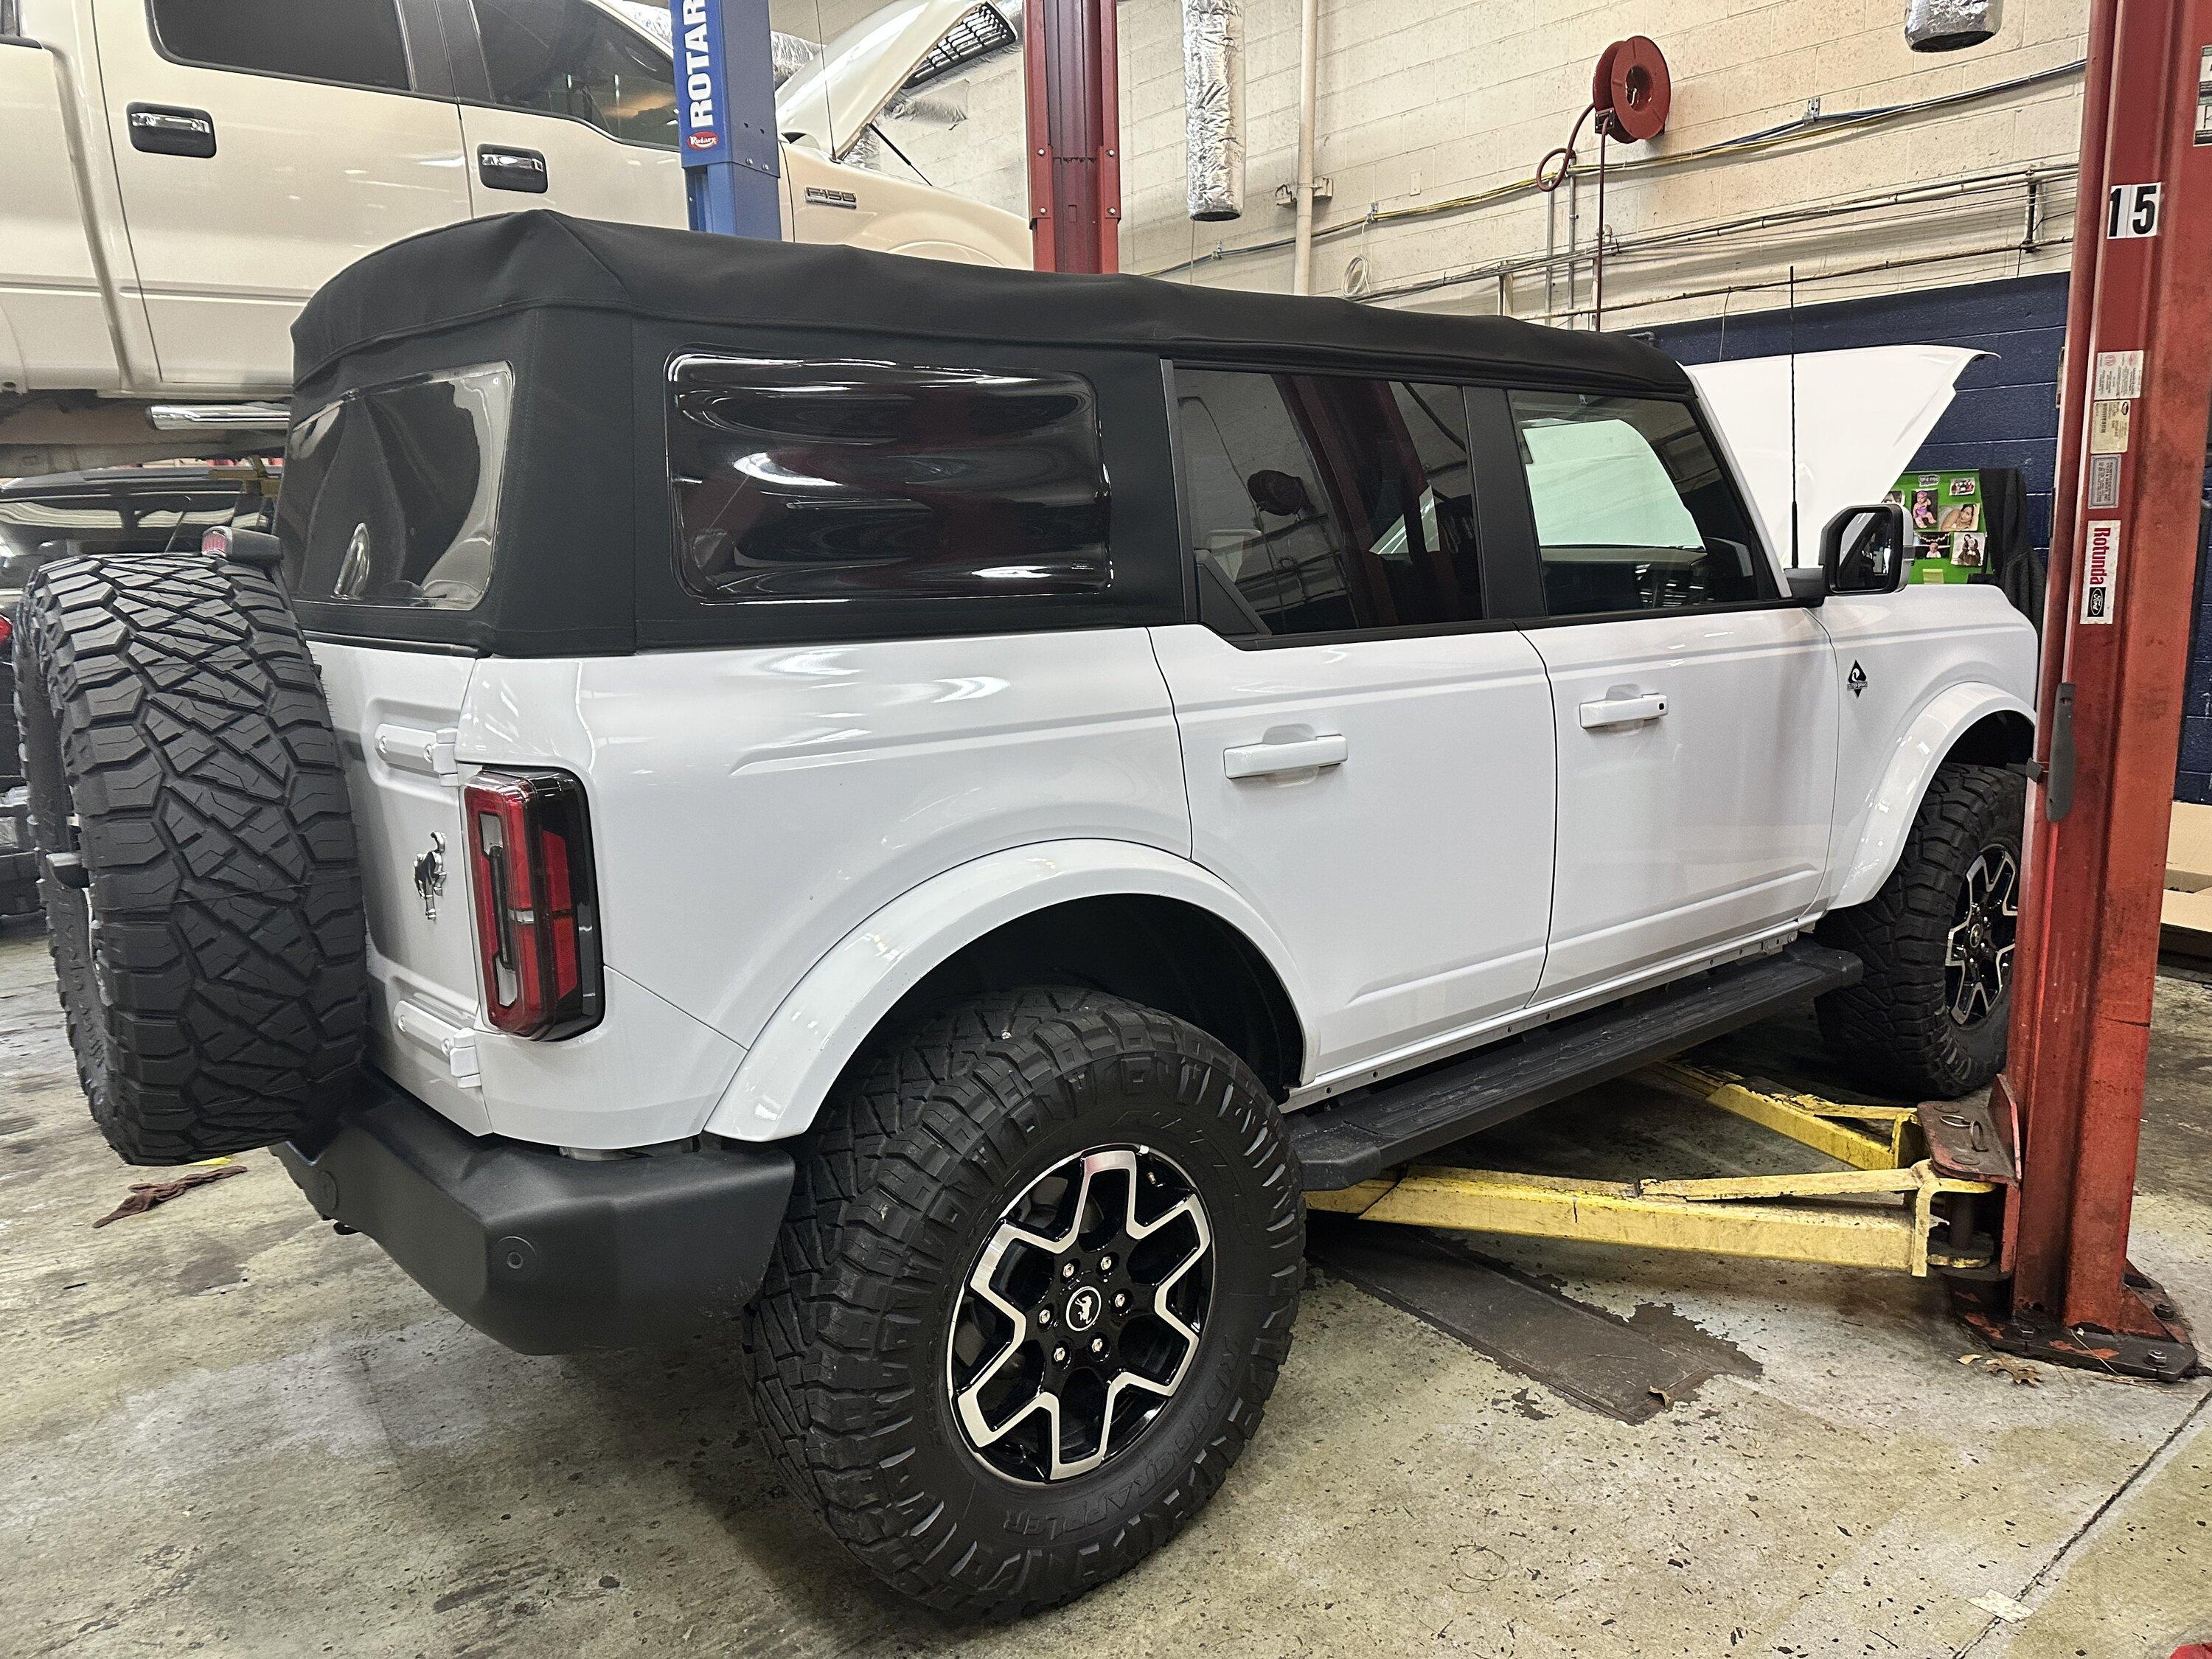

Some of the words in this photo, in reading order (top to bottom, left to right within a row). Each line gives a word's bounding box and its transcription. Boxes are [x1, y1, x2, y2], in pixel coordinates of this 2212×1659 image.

[689, 136, 717, 147] Rotary
[806, 187, 857, 203] F-150
[2109, 185, 2157, 237] 15
[2090, 527, 2111, 585] Rotunda
